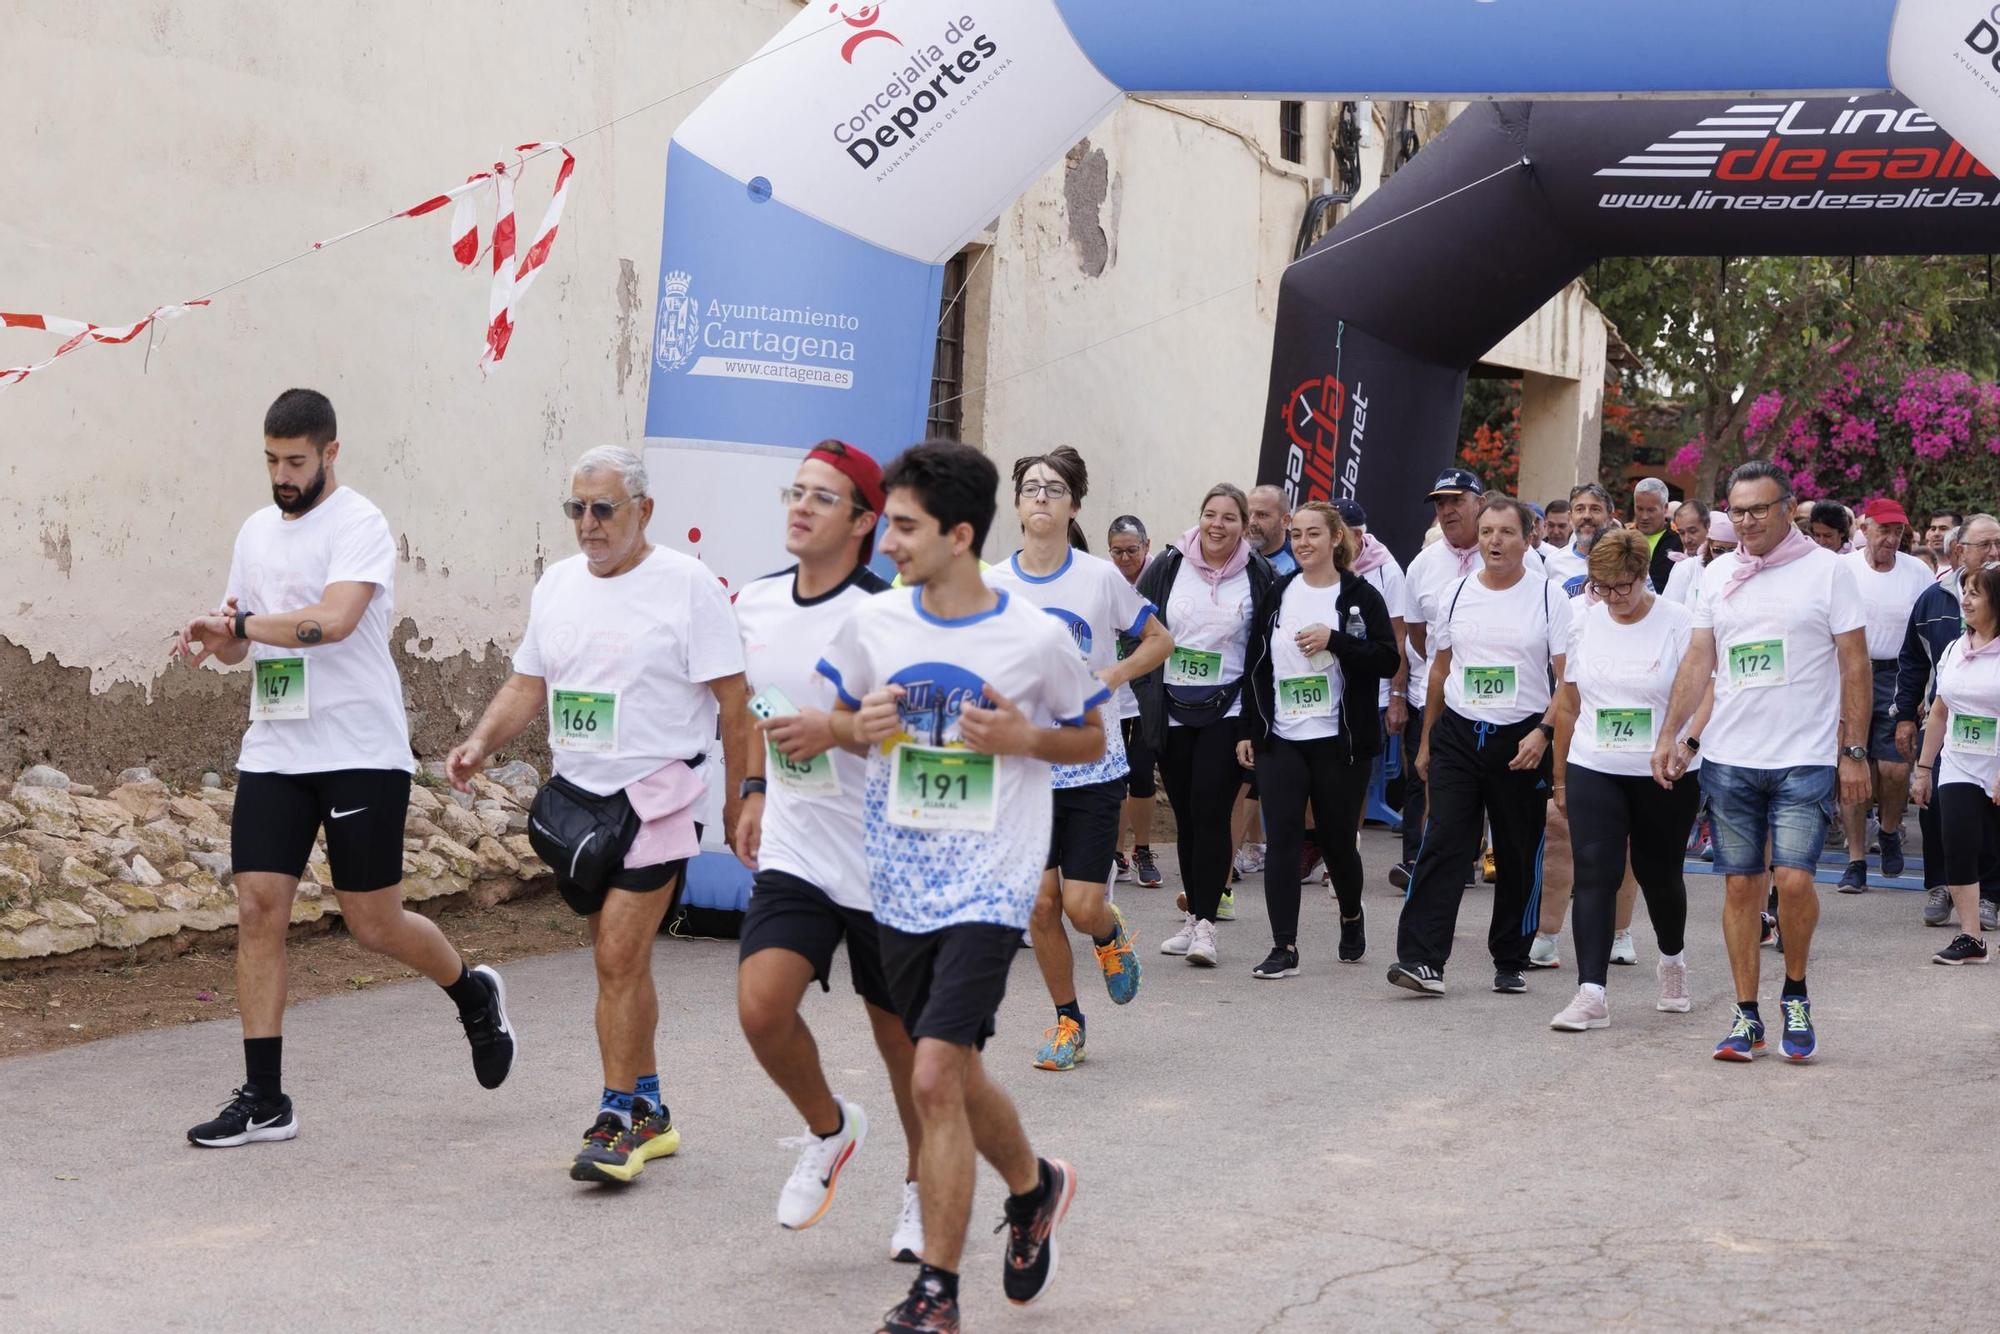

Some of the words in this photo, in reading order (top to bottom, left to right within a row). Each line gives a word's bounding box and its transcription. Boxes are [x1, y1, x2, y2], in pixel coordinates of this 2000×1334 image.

[834, 45, 944, 143] Concejalía
[944, 15, 975, 45] de
[846, 34, 997, 169] Deportes
[876, 121, 943, 183] AYUNTAMIENTO
[945, 107, 958, 120] DE
[960, 58, 1013, 107] CARTAGENA
[1715, 138, 1827, 181] de
[706, 299, 859, 331] Ayuntamiento
[704, 322, 855, 361] Cartagena
[725, 361, 849, 384] www.cartagena.es
[1181, 659, 1208, 677] 153
[1739, 654, 1771, 673] 172
[264, 676, 290, 697] 147
[1293, 688, 1321, 704] 150
[1474, 679, 1504, 694] 120
[563, 708, 597, 731] 166
[1612, 721, 1634, 737] 74
[1964, 726, 1980, 740] 15
[917, 772, 967, 801] 191
